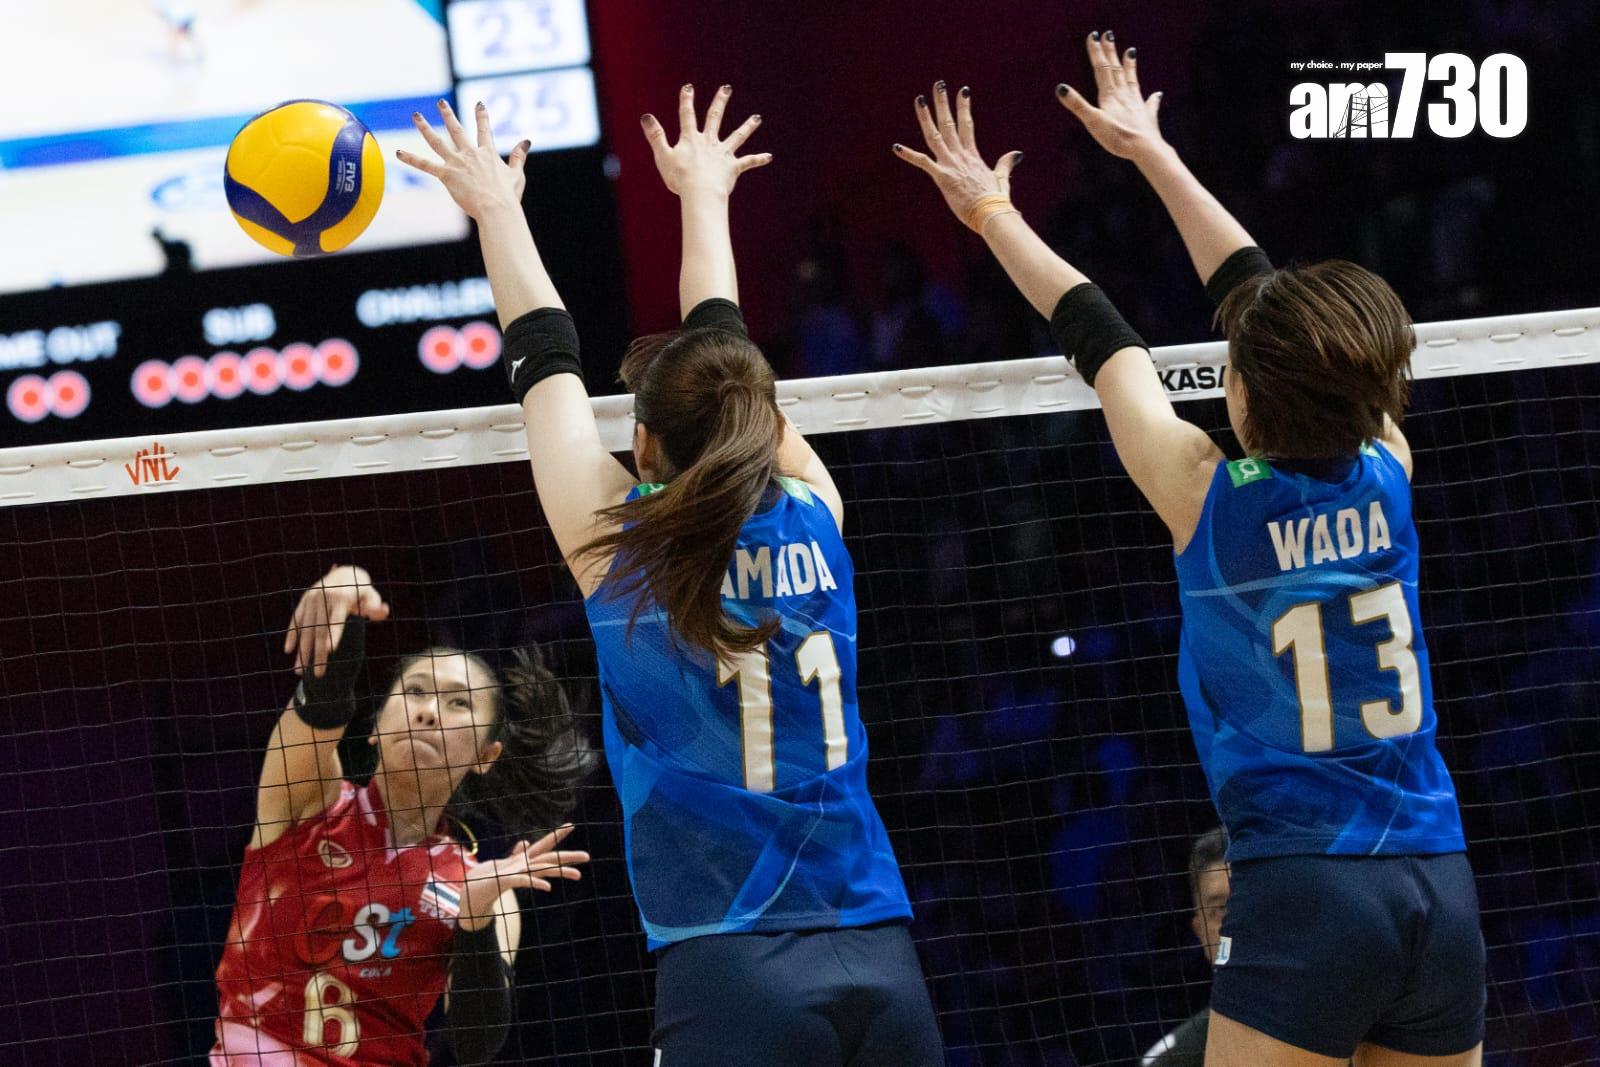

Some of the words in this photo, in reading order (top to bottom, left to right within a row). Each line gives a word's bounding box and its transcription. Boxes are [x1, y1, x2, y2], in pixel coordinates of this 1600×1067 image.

[344, 162, 356, 192] FIVB
[46, 321, 121, 364] OUT
[203, 303, 276, 346] SUB
[125, 442, 180, 485] VNL
[1267, 501, 1392, 571] WADA
[1271, 582, 1422, 754] 13
[716, 631, 848, 793] 11
[304, 972, 362, 1058] 6
